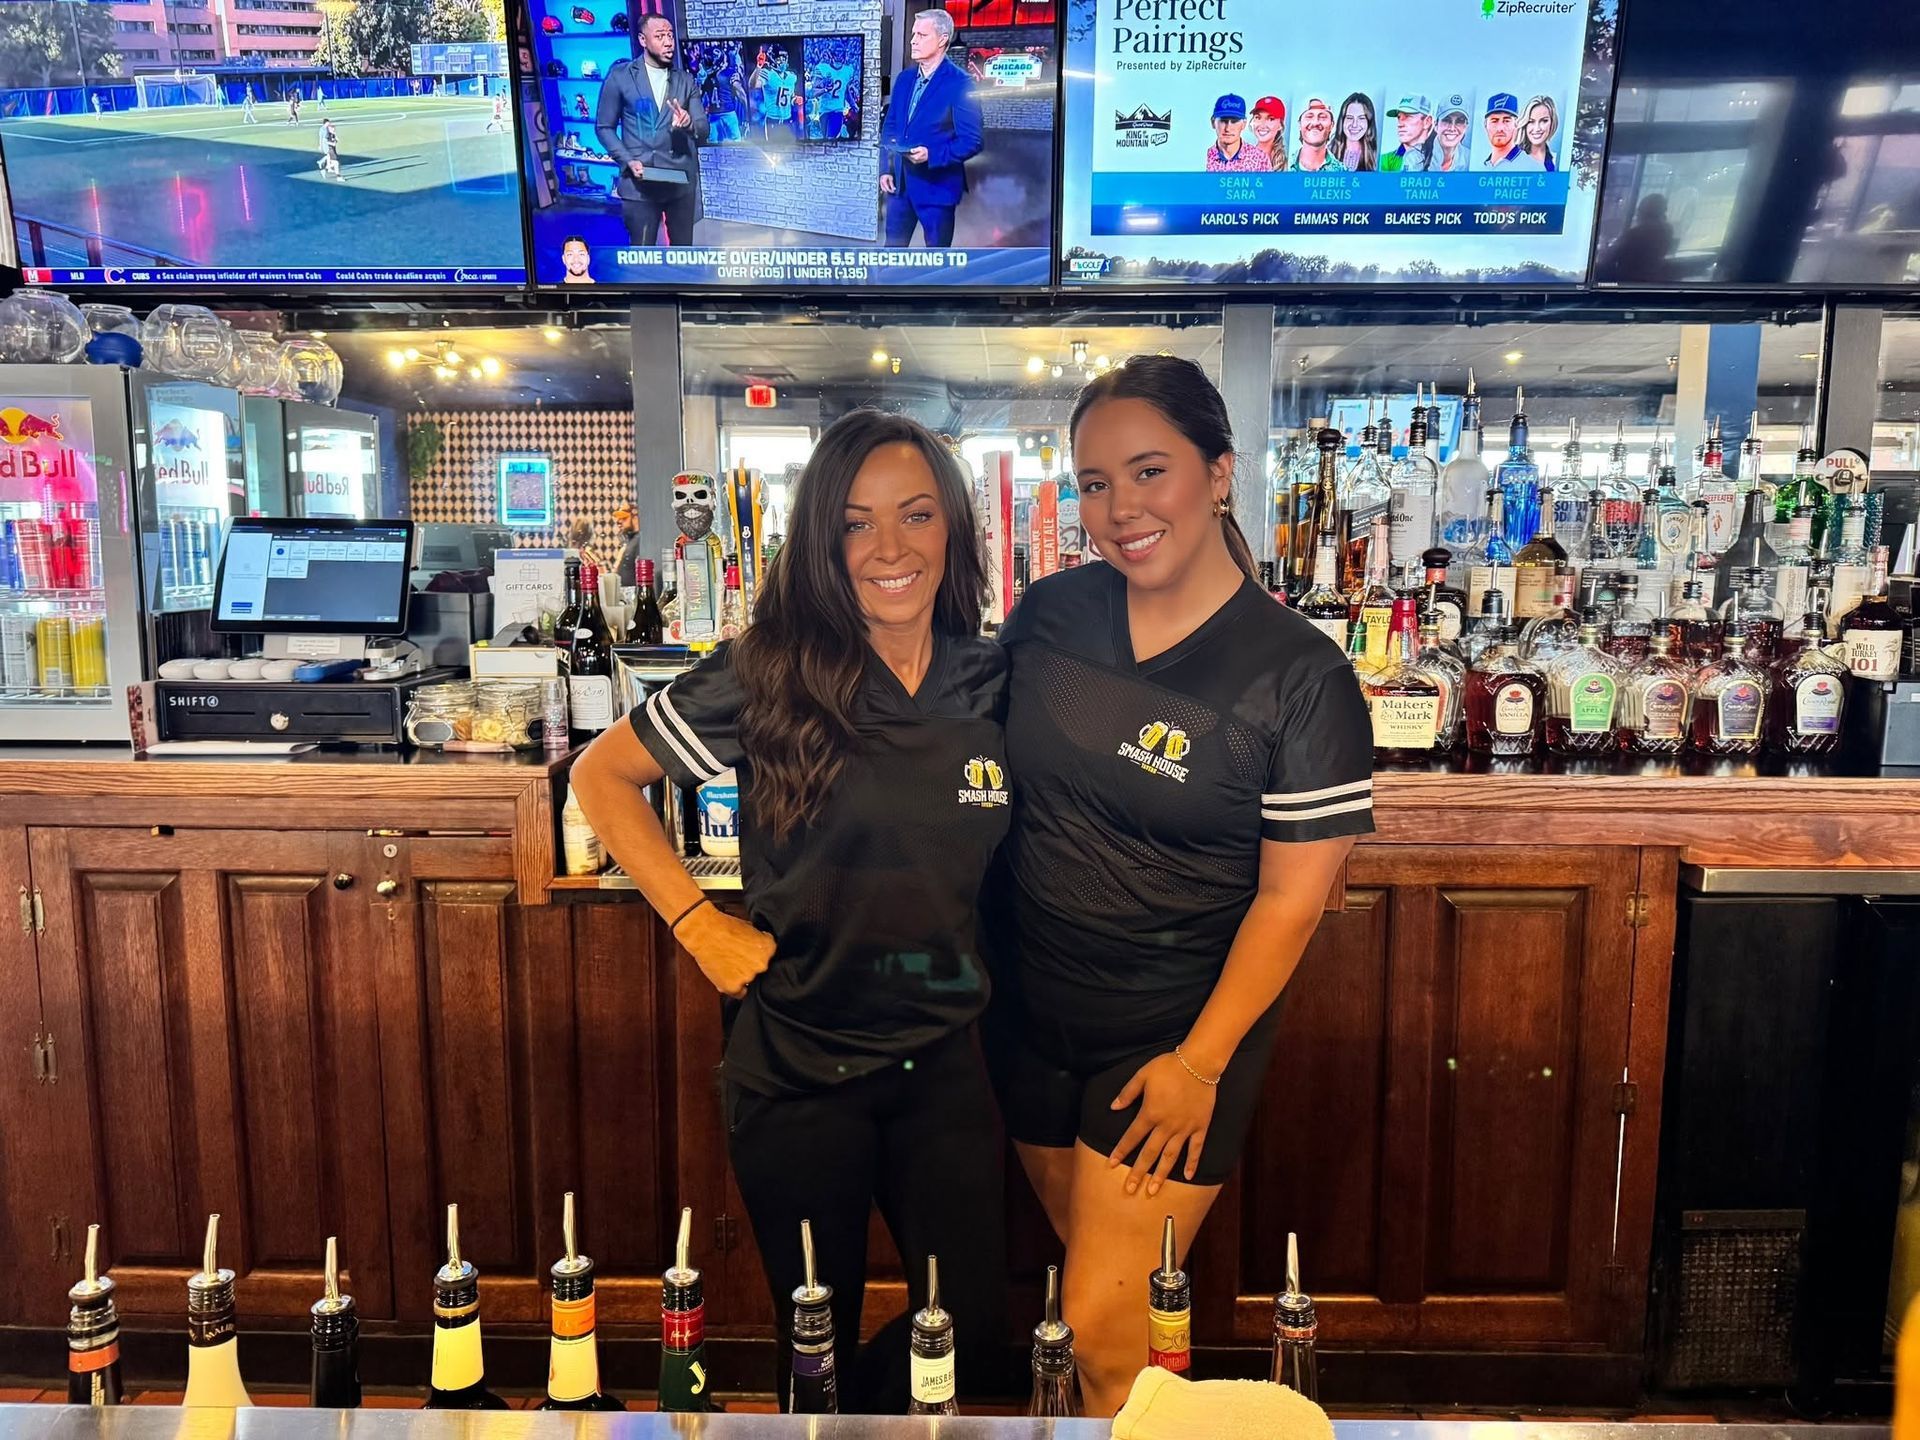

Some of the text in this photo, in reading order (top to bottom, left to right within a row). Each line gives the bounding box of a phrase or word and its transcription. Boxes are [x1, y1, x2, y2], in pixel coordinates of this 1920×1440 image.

[1114, 0, 1227, 20] Perfect
[1497, 1, 1574, 16] ZipRecruiter
[1113, 24, 1243, 61] Pairings
[1117, 60, 1246, 72] Presented by ZipRecruiter
[777, 87, 790, 107] 15
[1126, 130, 1142, 139] KING
[1220, 177, 1264, 188] SEAN &
[1304, 177, 1360, 188] BUBBIE &
[1400, 177, 1446, 188] BRAD &
[1479, 176, 1532, 187] GARRETT
[1226, 190, 1256, 200] SARA
[1311, 190, 1352, 200] ALEXIS
[1406, 190, 1440, 200] TANIA
[1494, 189, 1528, 200] PAIGE
[1201, 213, 1280, 225] KAROL'S PICK
[1294, 213, 1370, 225] EMMA'S PICK
[1384, 213, 1462, 224] BLAKE'S PICK
[1474, 212, 1547, 224] TODD'S PICK
[618, 251, 968, 266] ROME ODUNZE OVER/UNDER 5.5 RECEIVING TD
[718, 266, 748, 278] OVER
[794, 268, 832, 278] UNDER
[21, 449, 76, 478] Bull
[1826, 458, 1856, 468] PULL
[1043, 517, 1055, 576] WHEAT ALE
[1851, 648, 1877, 658] TURKEY
[1856, 643, 1875, 651] WILD
[1850, 658, 1878, 672] 101
[1382, 700, 1434, 709] Maker's
[1395, 711, 1432, 720] Mark
[1117, 742, 1190, 783] SMASH HOUSE
[958, 790, 1008, 806] SMASH HOUSE
[1159, 1354, 1186, 1370] Captain
[921, 1376, 943, 1388] JAMES
